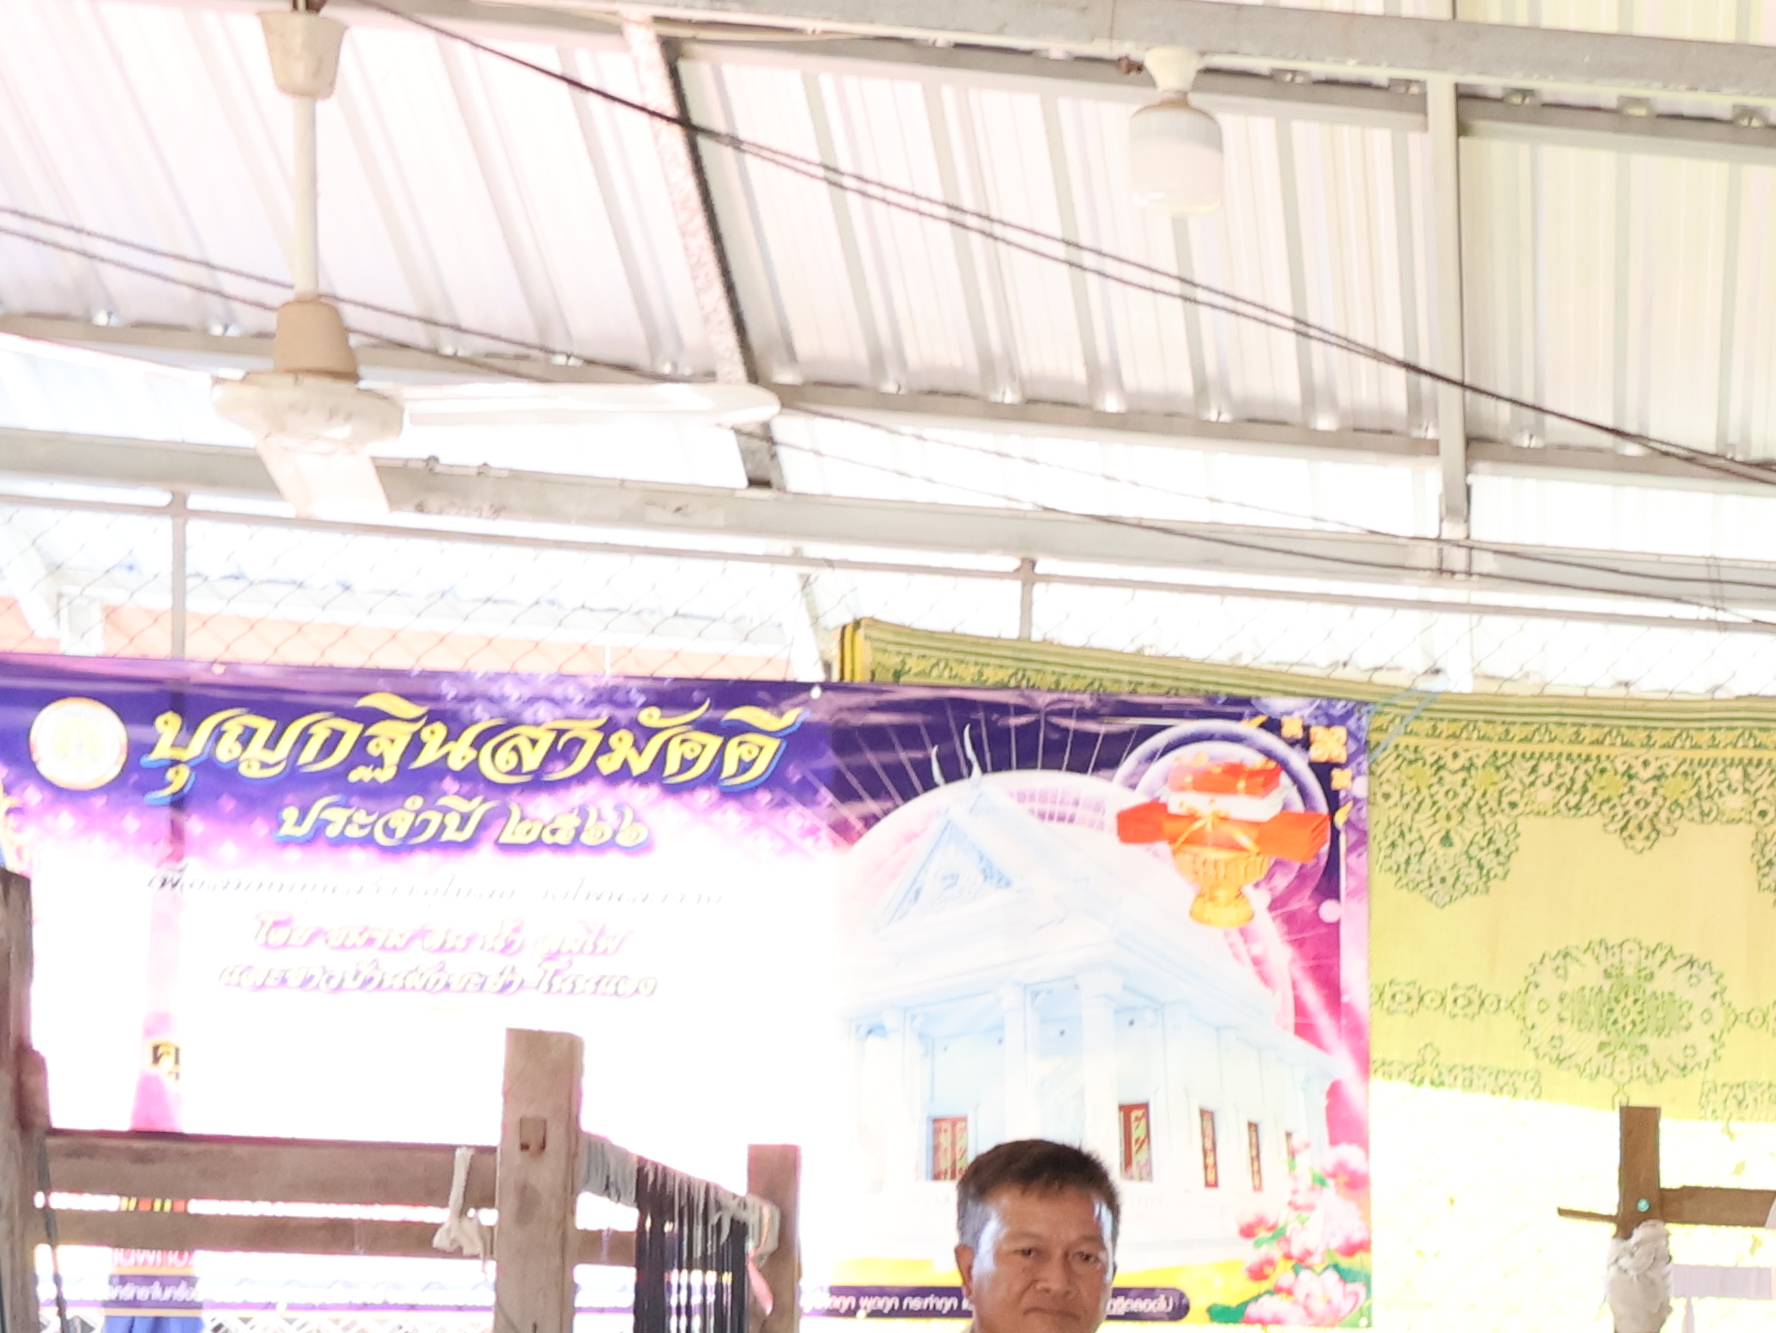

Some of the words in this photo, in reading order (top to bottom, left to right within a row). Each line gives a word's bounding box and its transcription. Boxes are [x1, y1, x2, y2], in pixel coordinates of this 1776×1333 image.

[142, 692, 806, 804] บุญกฐินสามัคคี
[276, 795, 484, 848] ประจำปี
